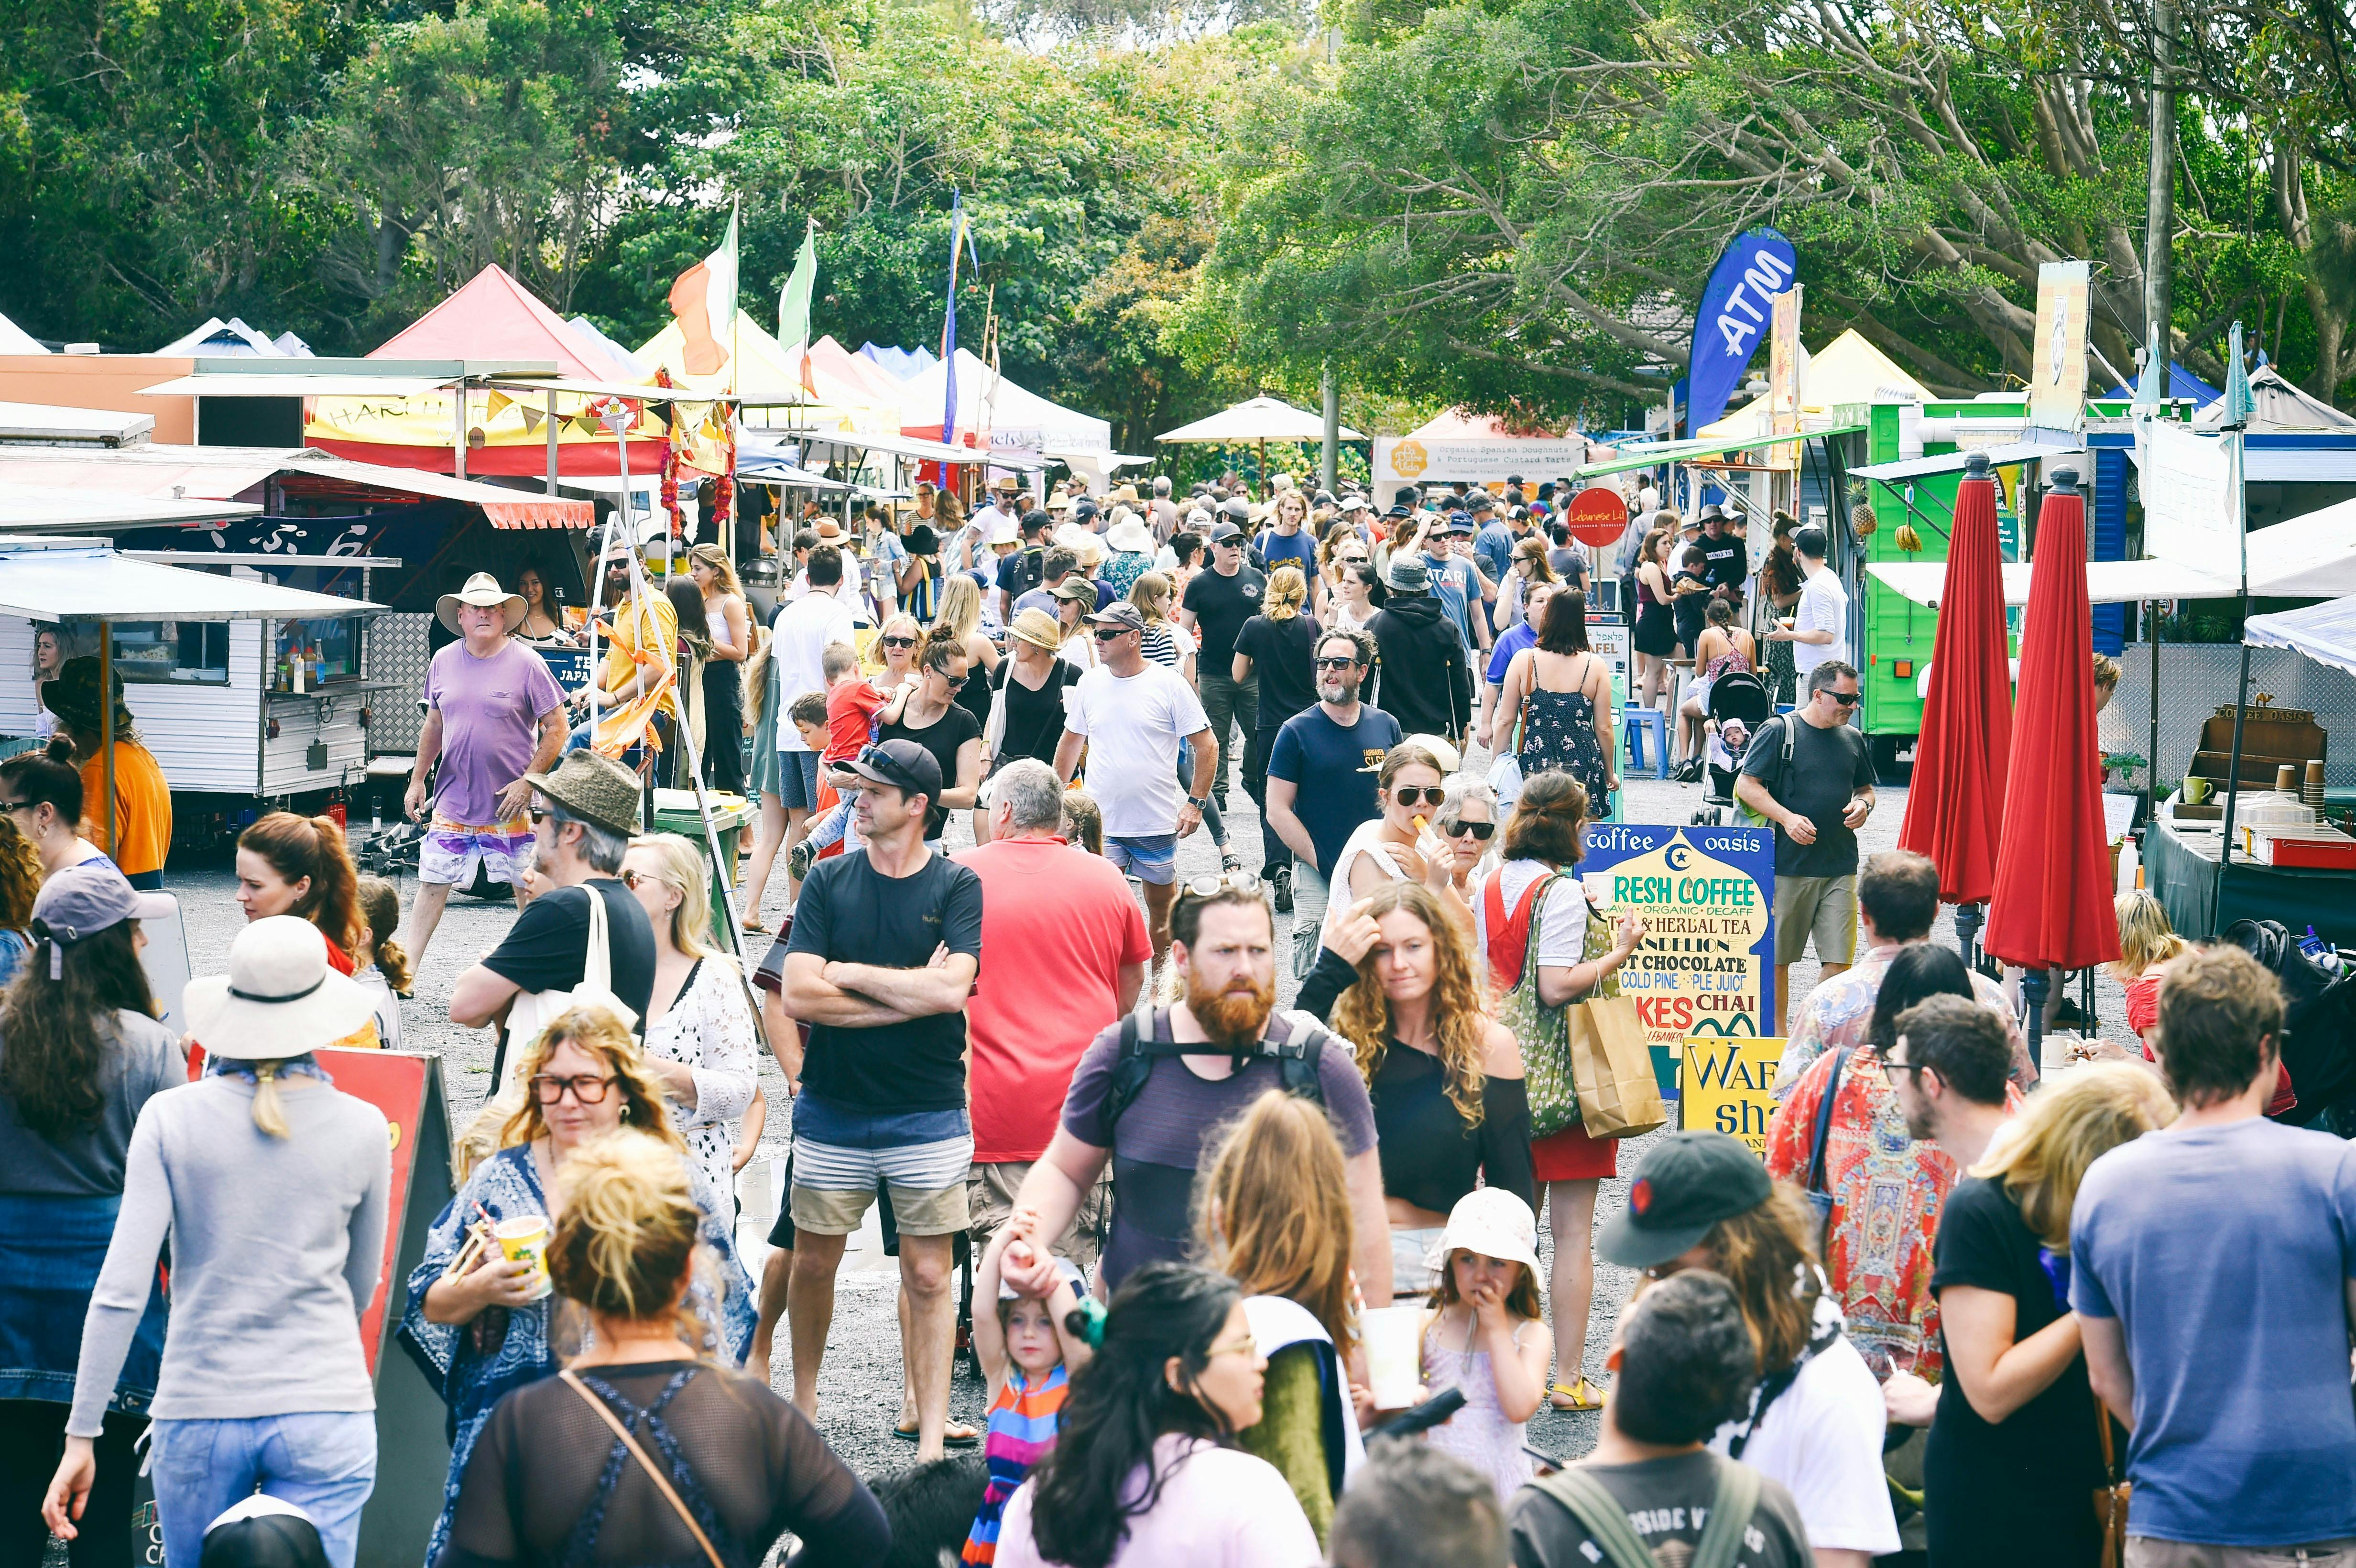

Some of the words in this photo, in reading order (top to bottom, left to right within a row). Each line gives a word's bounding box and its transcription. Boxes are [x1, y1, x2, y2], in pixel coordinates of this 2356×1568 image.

[1717, 250, 1792, 357] ATM
[1570, 509, 1611, 522] Lebanese
[1613, 509, 1625, 521] Lil
[1426, 567, 1467, 584] ATARI
[2218, 709, 2261, 719] COEE
[2271, 711, 2304, 721] OASIS
[1586, 827, 1655, 851] coffee
[1705, 833, 1761, 852] oasis
[1614, 876, 1672, 904] RESH
[1679, 878, 1755, 906] COFFEE
[1643, 905, 1699, 915] ORGANIC
[1707, 906, 1753, 916] DECAFF
[1642, 917, 1653, 932] &
[1721, 918, 1751, 935] TEA
[1642, 956, 1747, 973] CHOCOLATE
[1621, 971, 1650, 989] COLD
[1655, 972, 1712, 991] PINEPLE
[1636, 996, 1693, 1029] KES
[1696, 994, 1755, 1012] CHAI
